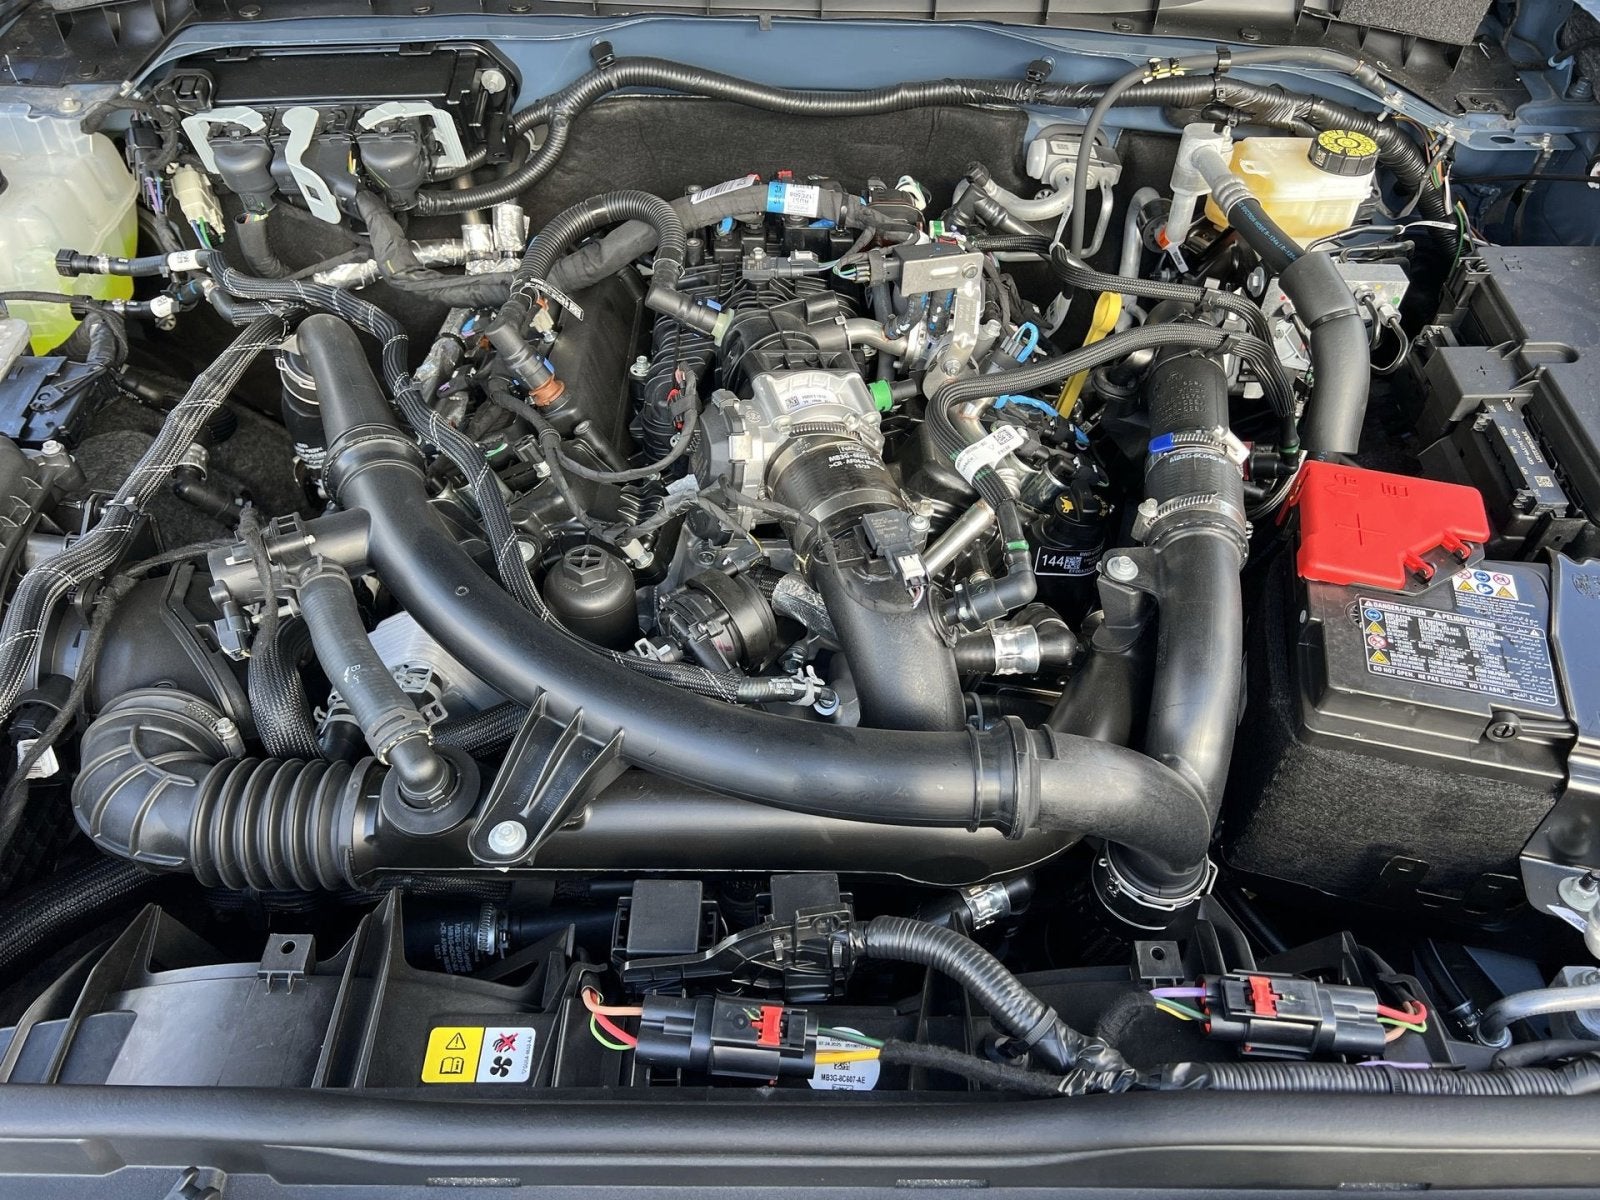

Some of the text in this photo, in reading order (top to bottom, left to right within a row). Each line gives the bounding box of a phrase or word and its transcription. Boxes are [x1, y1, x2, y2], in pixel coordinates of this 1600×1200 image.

[1042, 554, 1064, 567] 144
[1373, 601, 1427, 616] DANGER/POISON
[1441, 613, 1496, 629] PELIGRO/VENENO
[1383, 666, 1396, 674] NOT
[1397, 669, 1415, 677] OPEN.
[1427, 674, 1439, 682] PAS
[1440, 676, 1467, 687] OUVRIR.
